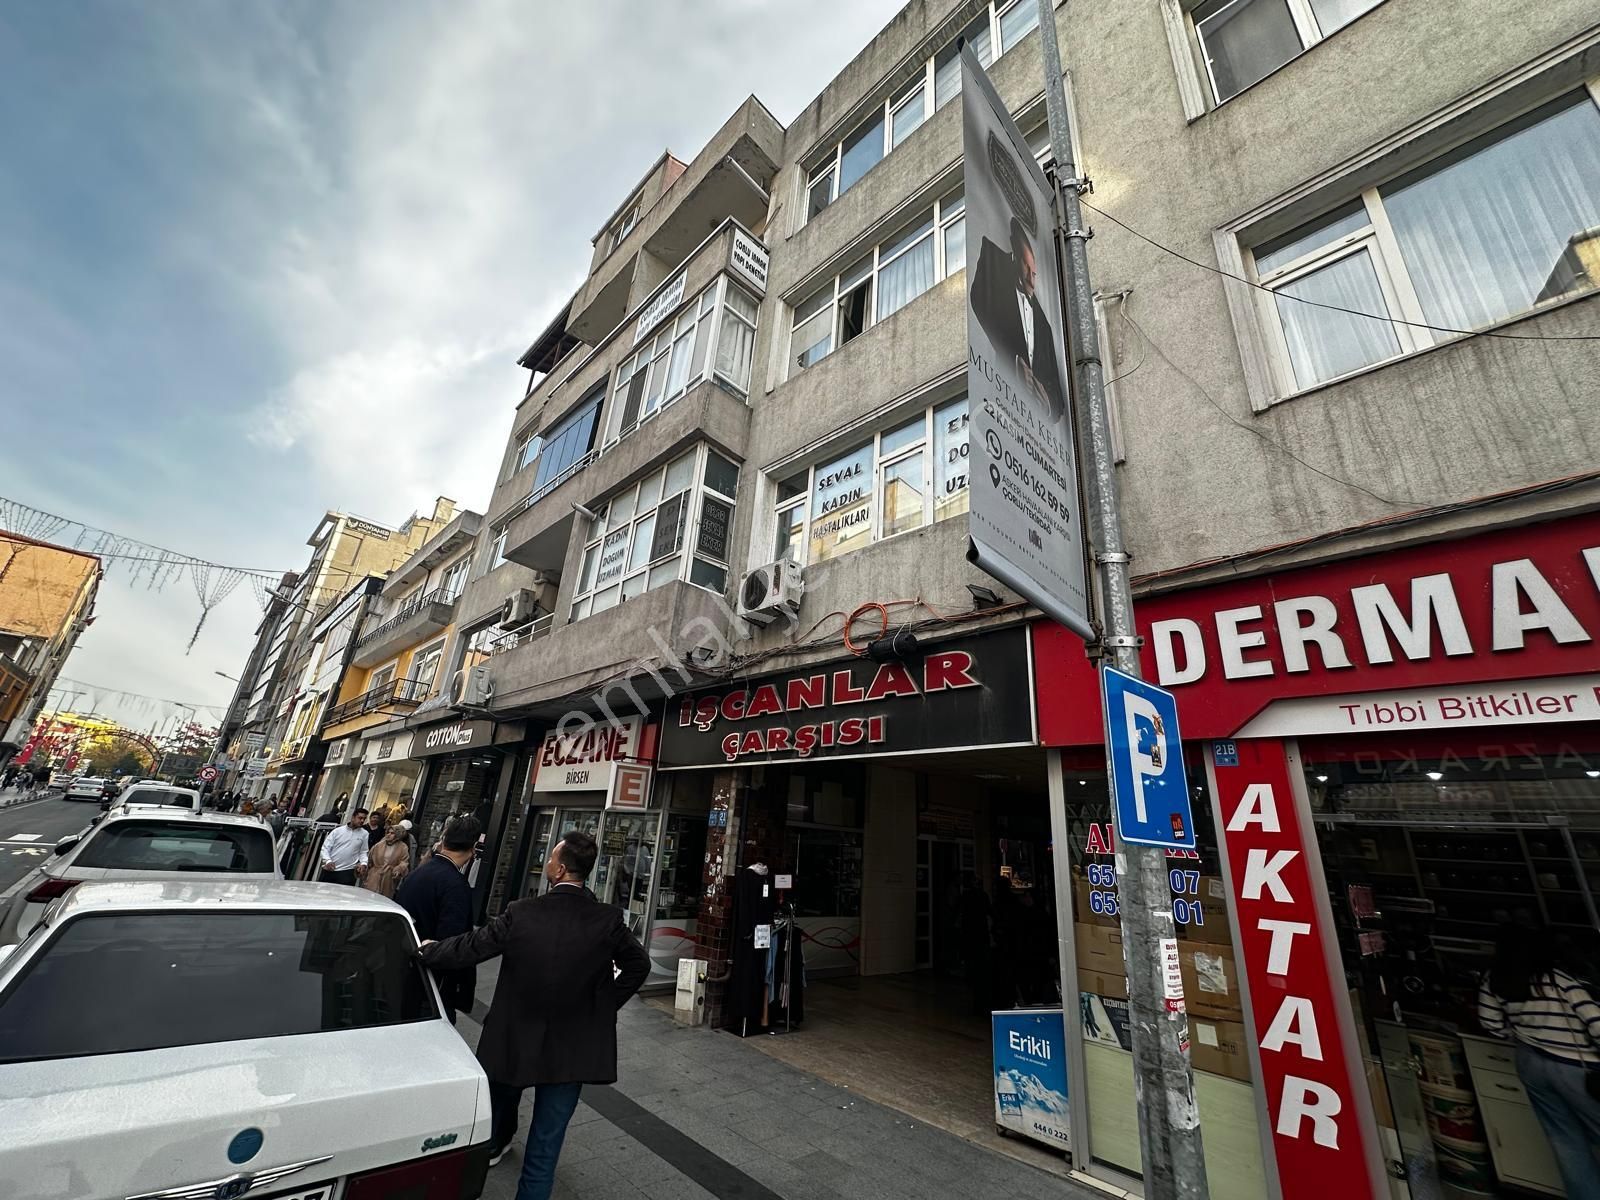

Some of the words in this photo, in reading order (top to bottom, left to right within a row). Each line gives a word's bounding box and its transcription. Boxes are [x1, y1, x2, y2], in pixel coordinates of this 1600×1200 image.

[969, 344, 1034, 429] MUSTAFA
[1038, 419, 1072, 471] KESER
[983, 396, 994, 420] 22
[996, 409, 1024, 449] KASIM
[818, 463, 862, 491] SEVAL
[946, 474, 969, 494] UZ
[1004, 448, 1029, 487] 0516
[1031, 473, 1046, 503] 162
[1047, 490, 1058, 514] 59
[1059, 501, 1070, 525] 59
[821, 487, 862, 514] KADIN
[813, 508, 870, 539] HASTALIKLARI
[679, 650, 980, 732] İŞCANLAR
[1437, 692, 1579, 720] Bitkiler
[425, 724, 461, 748] COTTON
[541, 722, 631, 768] ECZANE
[721, 714, 887, 762] ÇARŞISI
[1215, 743, 1236, 756] 21B
[1123, 690, 1168, 824] P
[565, 767, 590, 785] BİRSEN
[619, 771, 643, 802] E
[1088, 864, 1119, 888] 65
[1170, 868, 1200, 895] 07
[1090, 890, 1120, 916] 65
[1173, 898, 1204, 926] 01
[1226, 783, 1342, 1151] AKTAR
[1009, 1030, 1051, 1060] Erikli
[1001, 1094, 1016, 1102] Erikli
[1033, 1122, 1047, 1134] 444
[1054, 1129, 1068, 1141] 222
